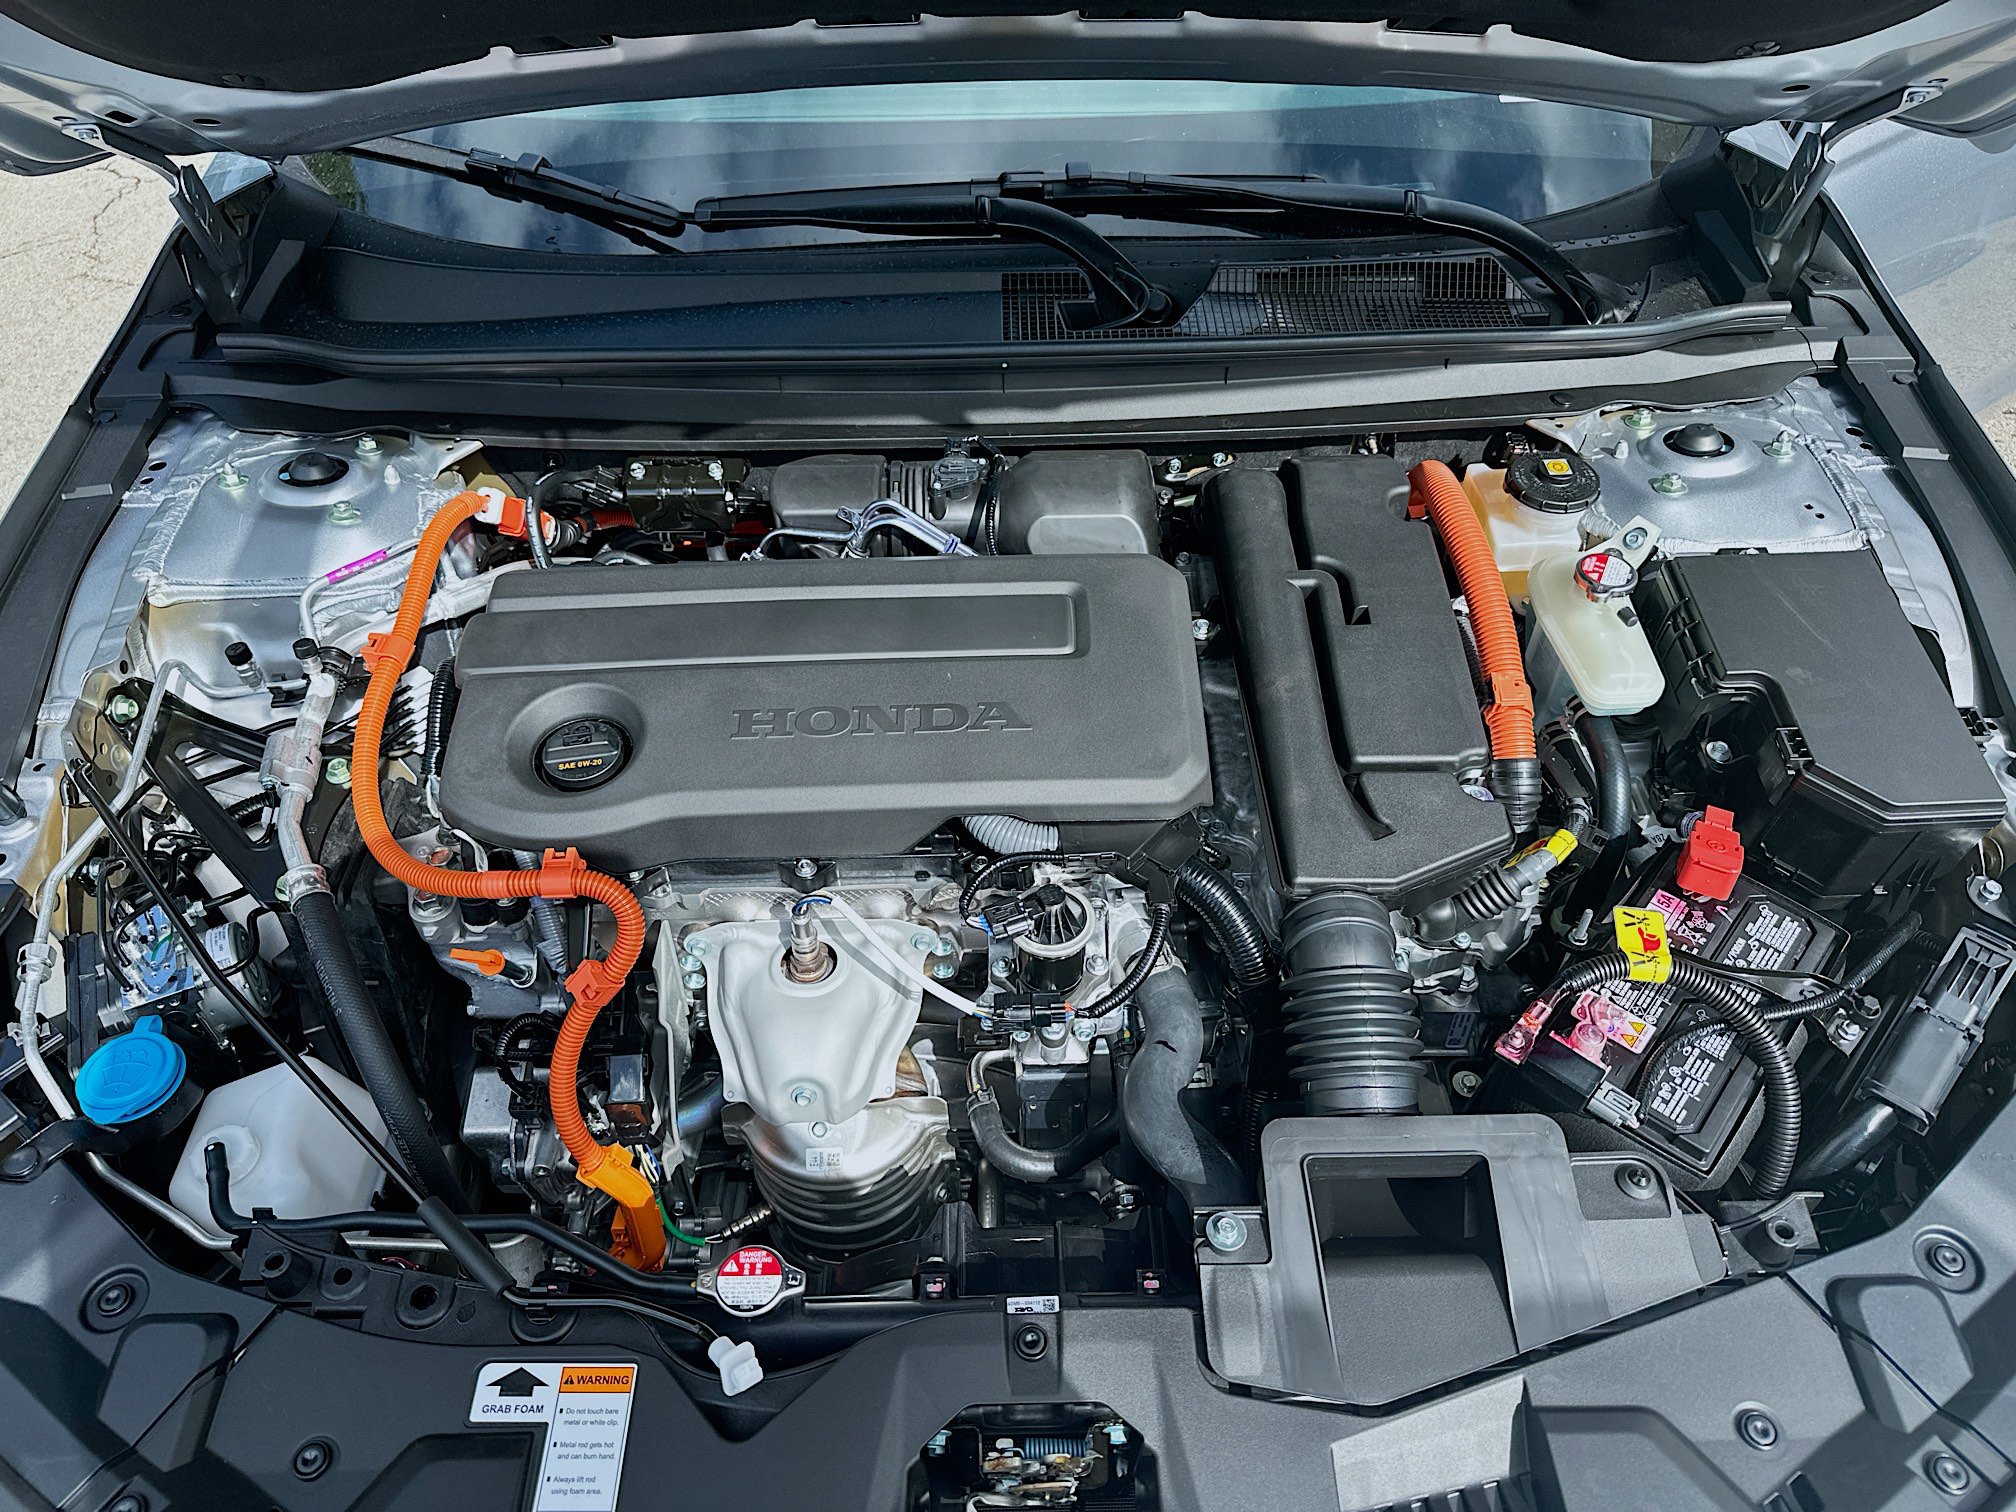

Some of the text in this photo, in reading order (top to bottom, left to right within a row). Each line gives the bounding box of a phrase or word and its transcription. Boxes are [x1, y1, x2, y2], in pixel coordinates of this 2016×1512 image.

[730, 702, 1033, 739] HONDA
[558, 759, 602, 770] SAE 0W-20
[577, 1375, 630, 1385] WARNING
[482, 1404, 544, 1414] GRAB FOAM
[606, 1419, 619, 1427] clip.
[552, 1476, 575, 1484] Always
